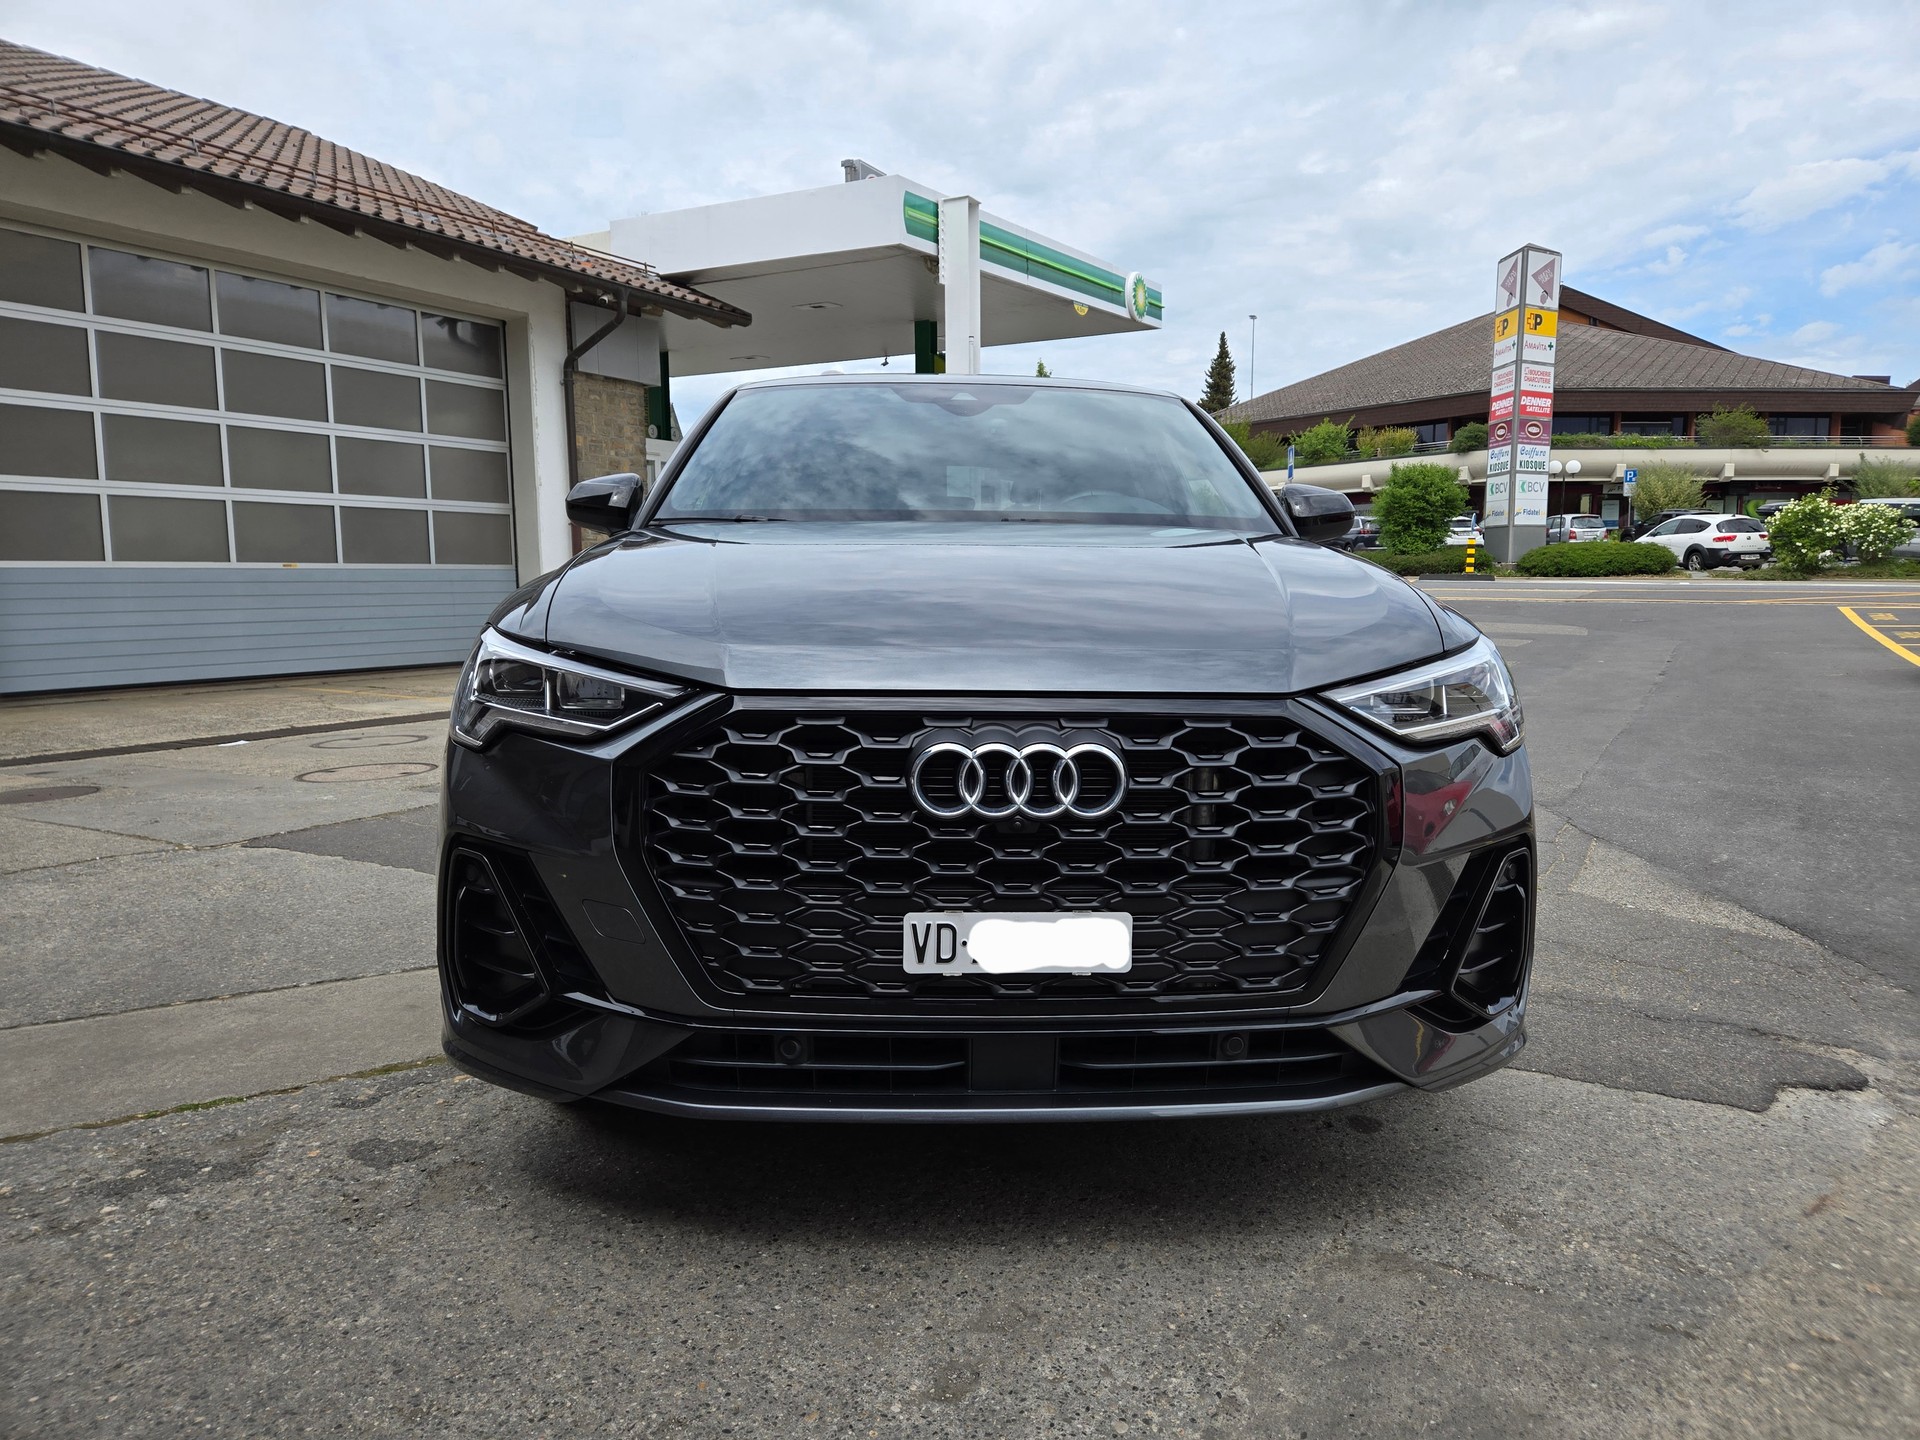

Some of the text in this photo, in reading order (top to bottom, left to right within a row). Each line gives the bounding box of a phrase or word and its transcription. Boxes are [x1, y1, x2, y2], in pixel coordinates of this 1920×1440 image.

[1523, 376, 1551, 384] CHARCUTERIE
[1491, 397, 1514, 411] DENNER
[1521, 396, 1552, 407] DENNER
[1520, 446, 1546, 459] Coiffure
[1489, 461, 1509, 472] KIOSQUE
[1519, 460, 1546, 470] KIOSQUE
[1527, 481, 1545, 493] BCV
[1523, 508, 1541, 516] Fidatel
